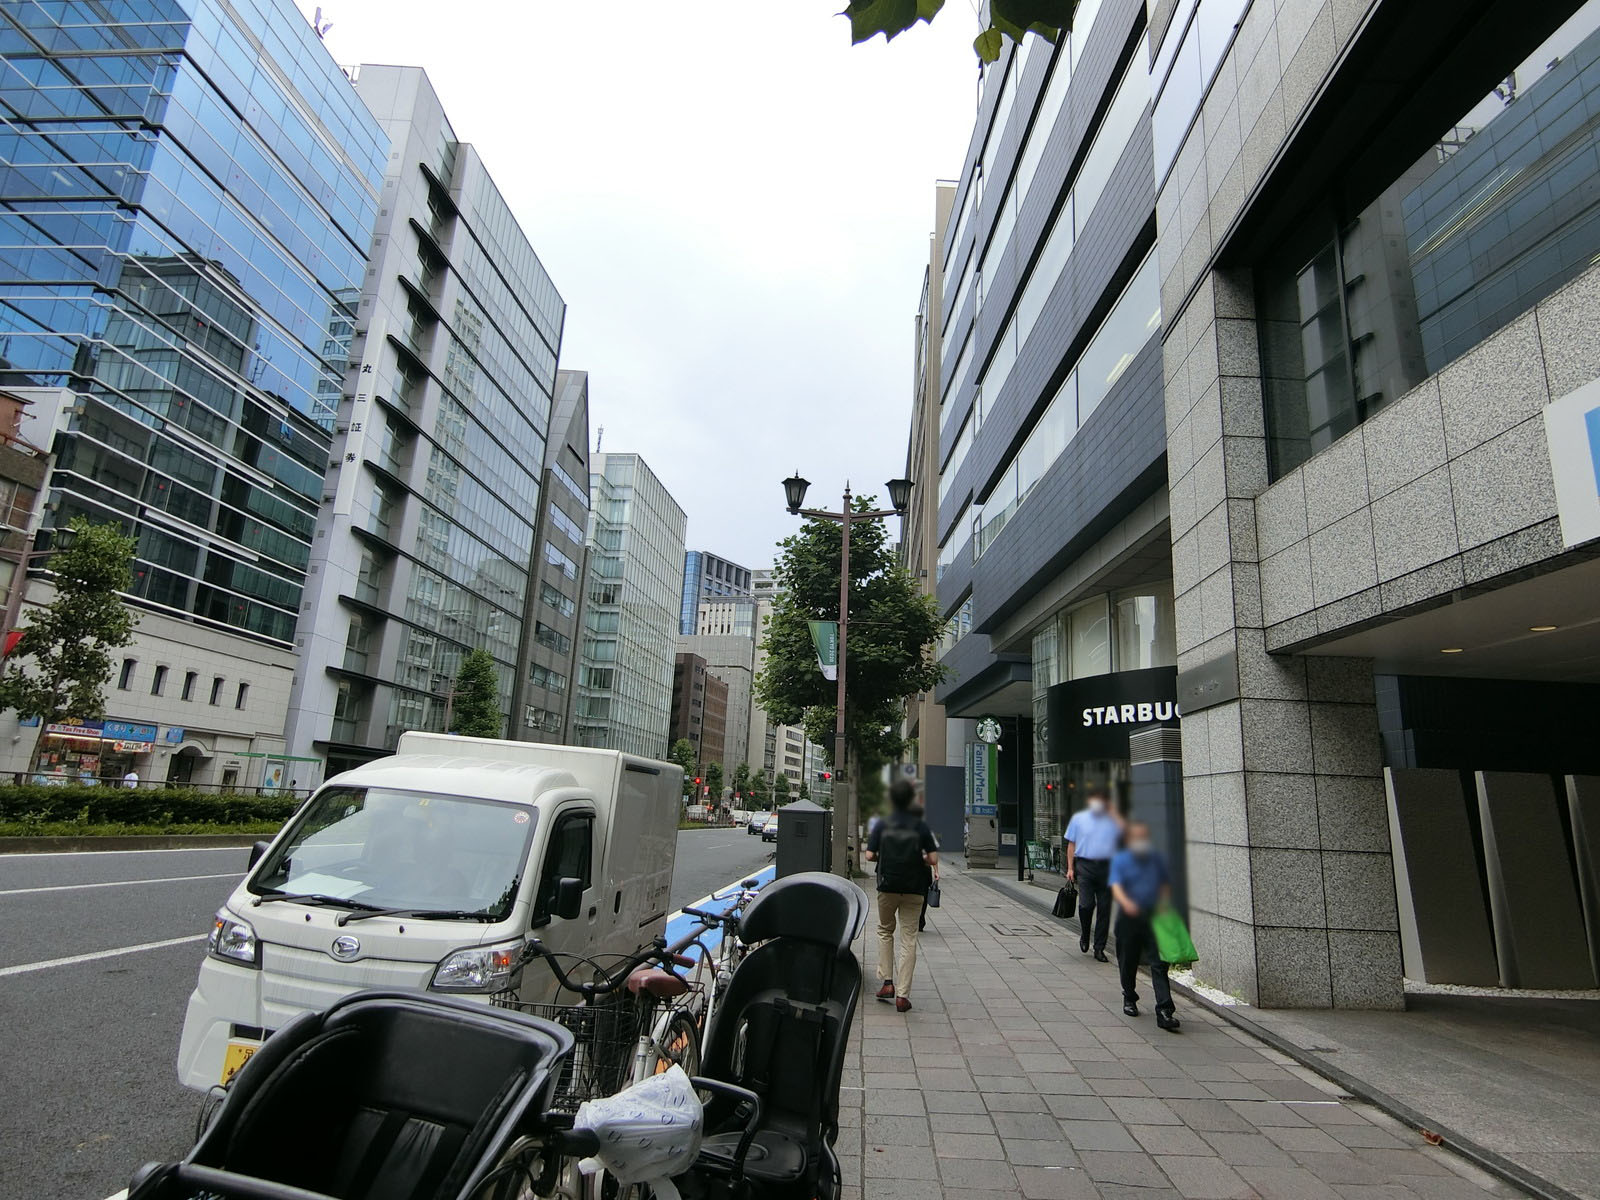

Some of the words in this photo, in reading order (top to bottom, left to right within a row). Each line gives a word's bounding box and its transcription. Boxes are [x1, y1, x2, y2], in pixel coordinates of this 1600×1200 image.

[345, 363, 372, 463] 丸三証券
[107, 723, 127, 733] くすり
[975, 744, 986, 803] FamilyMart
